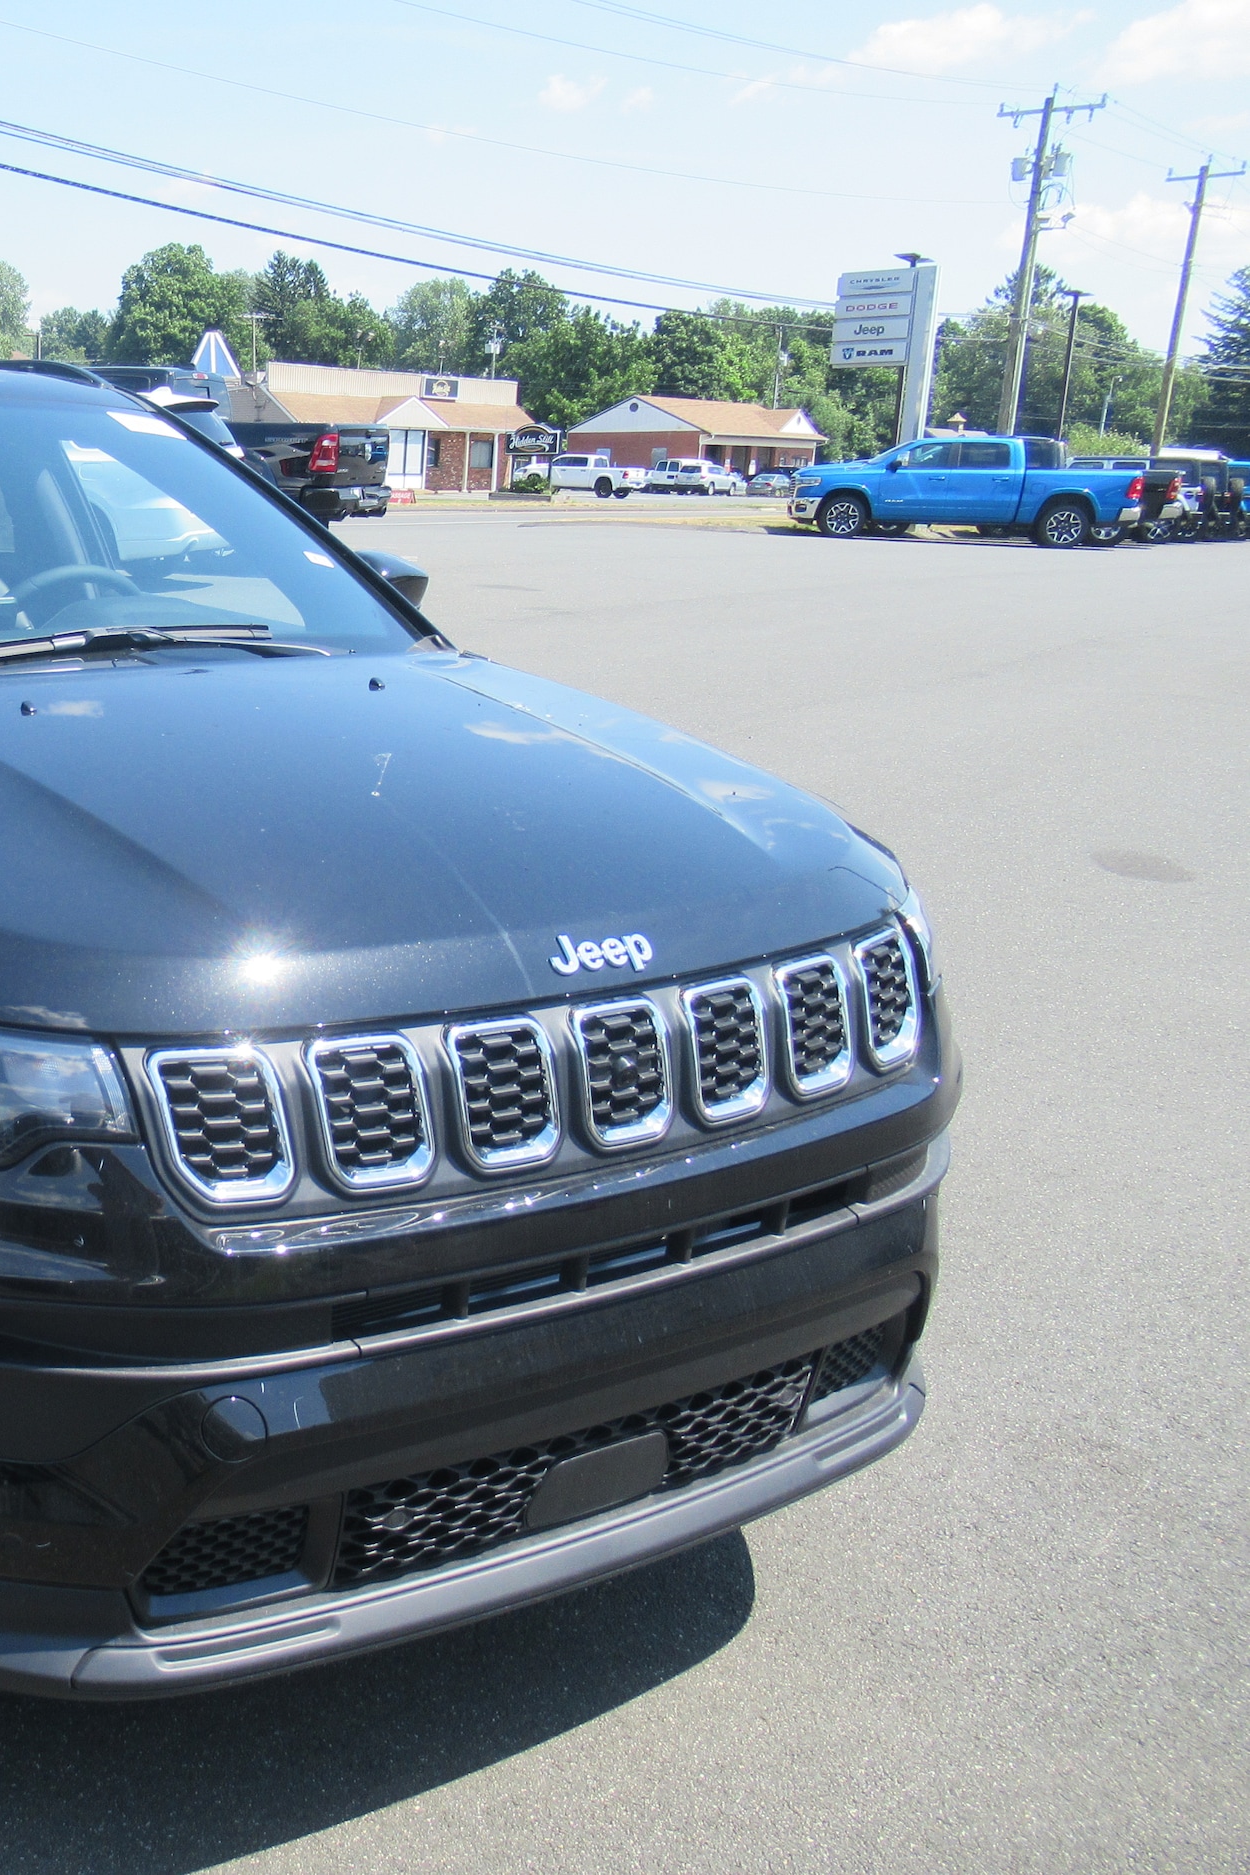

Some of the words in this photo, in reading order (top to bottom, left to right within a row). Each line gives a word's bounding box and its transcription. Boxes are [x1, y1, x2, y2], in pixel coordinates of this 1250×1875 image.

[849, 276, 900, 285] CHRYSLER
[845, 302, 899, 312] DODGE
[854, 324, 885, 337] Jeep
[856, 348, 894, 357] RAM
[509, 434, 536, 450] Hidden
[536, 434, 555, 445] Still
[549, 933, 654, 976] Jeep
